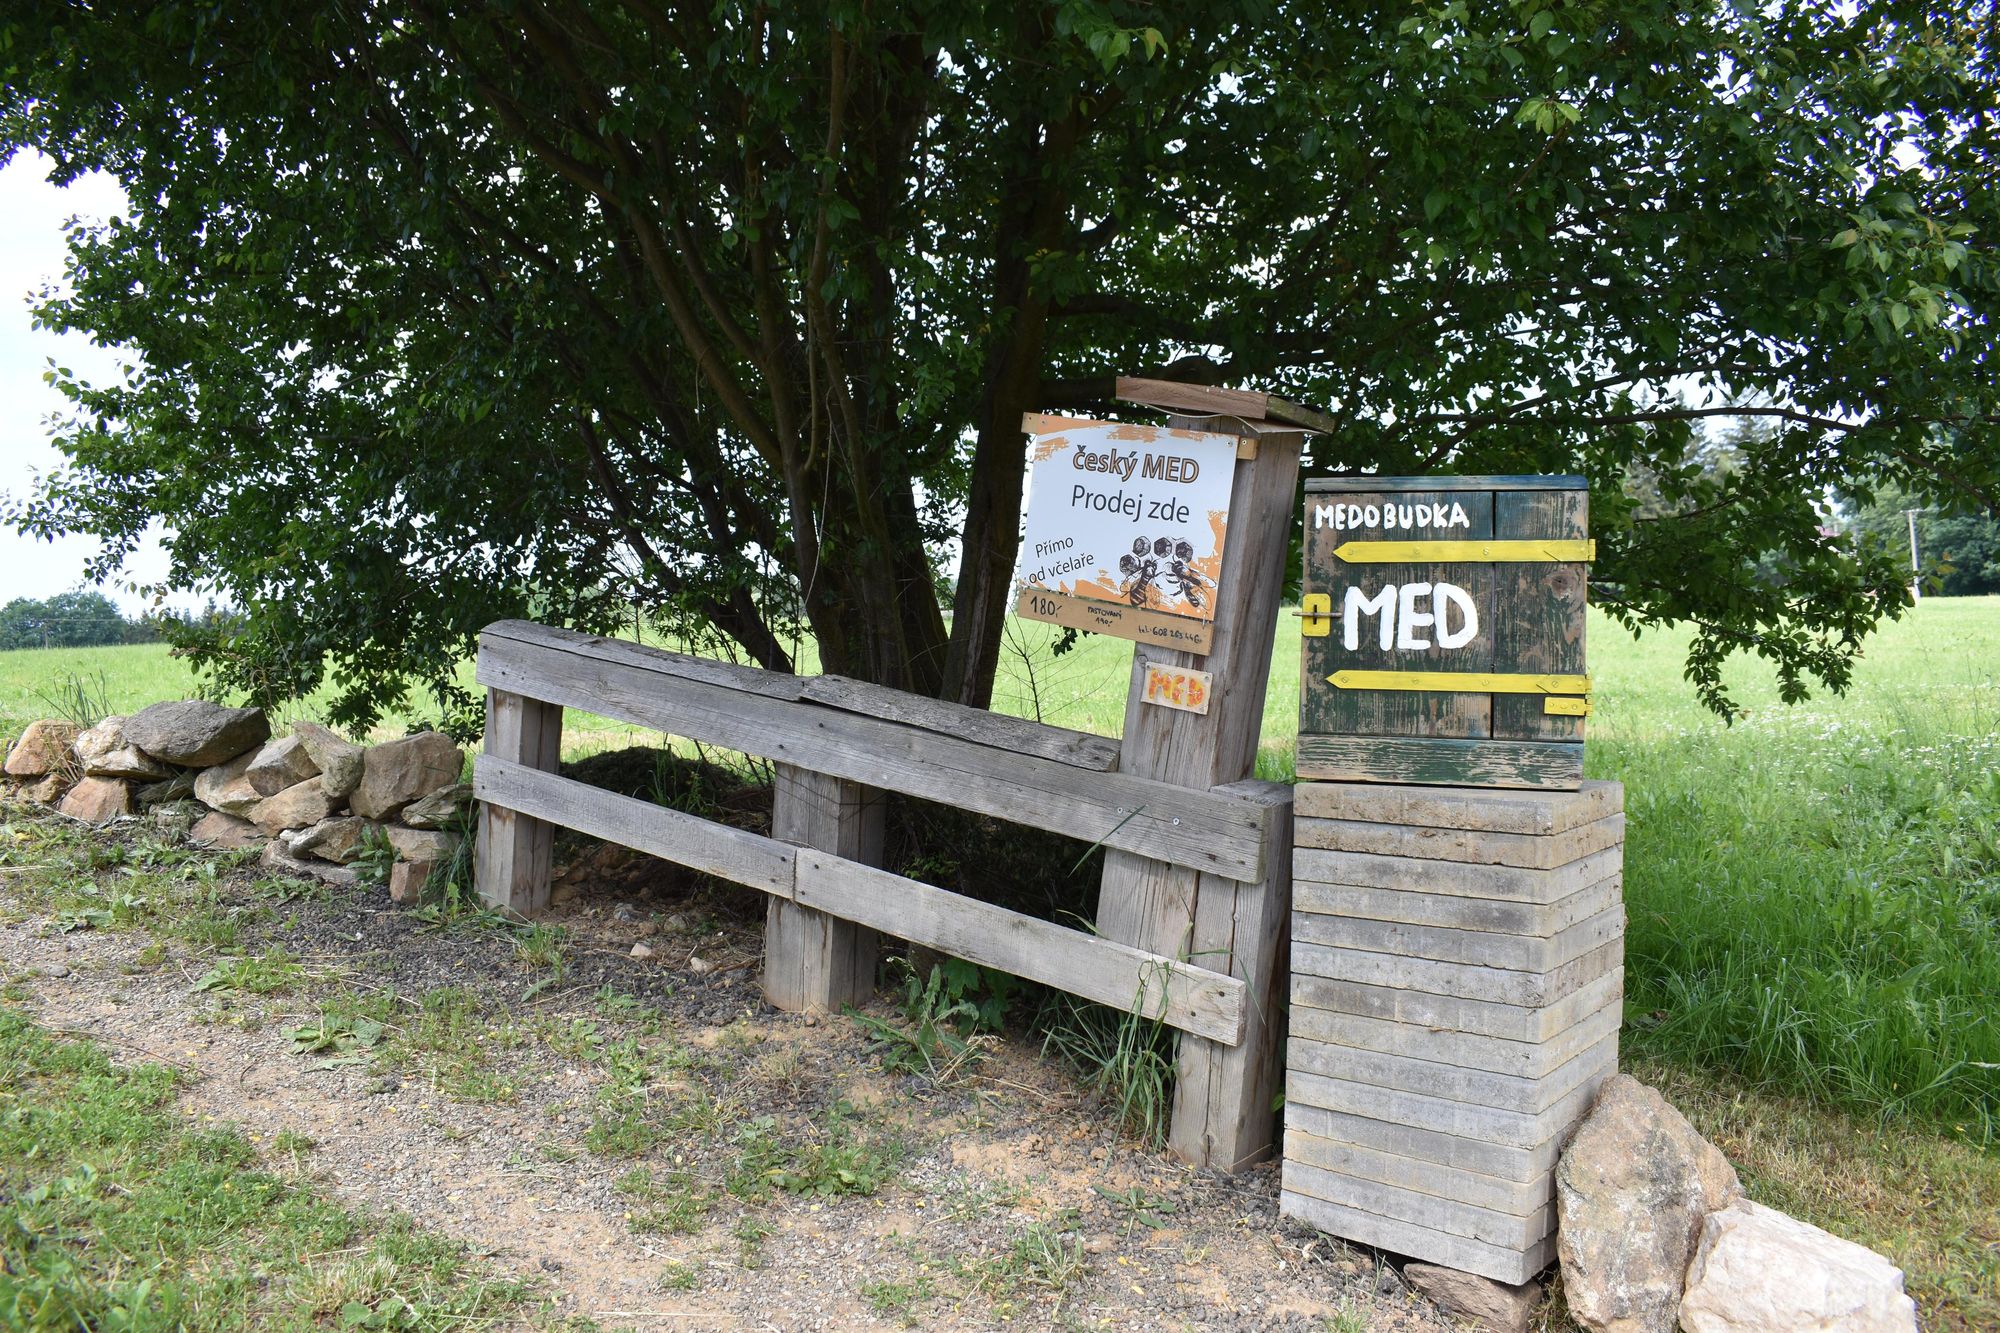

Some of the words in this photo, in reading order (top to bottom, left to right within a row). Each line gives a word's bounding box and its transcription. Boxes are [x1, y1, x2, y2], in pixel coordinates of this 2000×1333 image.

[1072, 444, 1139, 482] český
[1141, 453, 1200, 484] MED
[1071, 484, 1143, 523] Prodej
[1147, 497, 1190, 523] zde
[1315, 501, 1470, 529] MEDOBUDKA
[1035, 537, 1074, 558] Přímo
[1029, 566, 1046, 584] od
[1048, 552, 1095, 577] včelaře
[1152, 626, 1168, 637] 608
[1343, 582, 1479, 652] MED
[1148, 667, 1205, 707] MED
